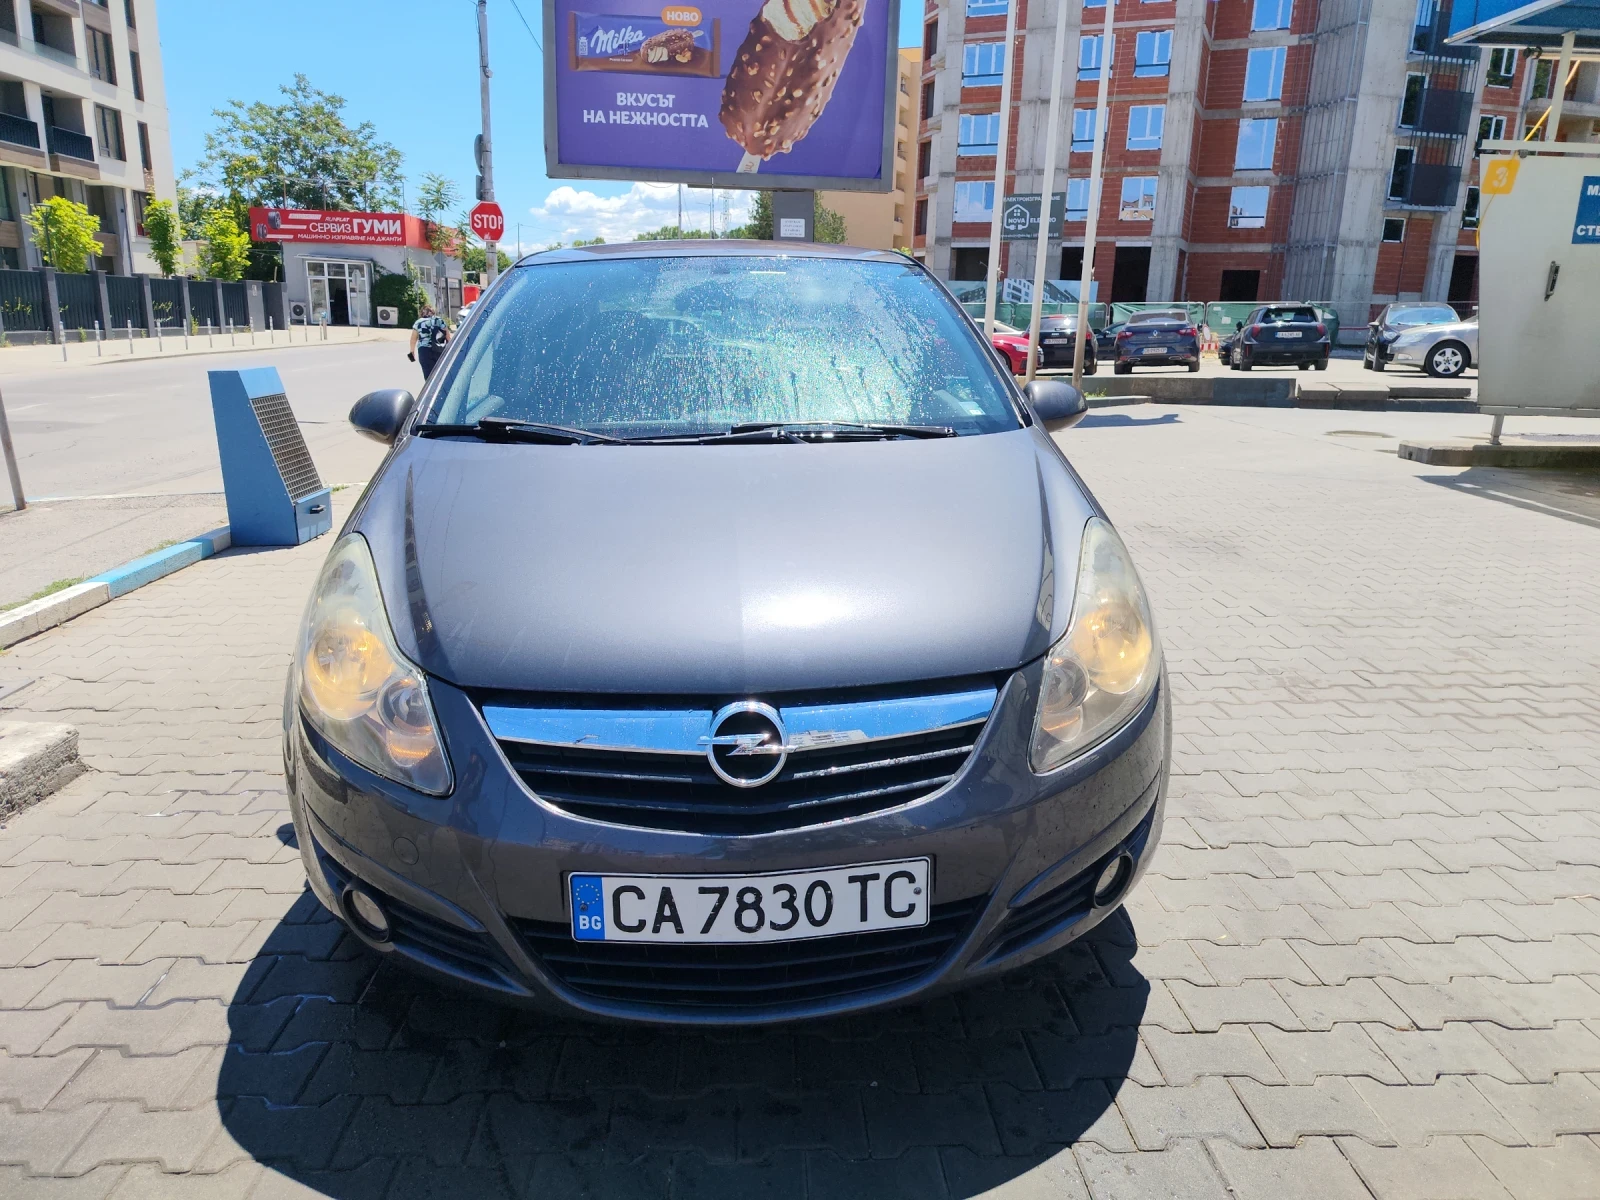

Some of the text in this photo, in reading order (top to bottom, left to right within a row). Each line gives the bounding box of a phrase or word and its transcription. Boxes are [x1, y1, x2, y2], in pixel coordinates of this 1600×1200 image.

[666, 11, 699, 22] НОВО
[590, 25, 645, 54] Milka
[616, 92, 676, 108] ВКУСЪТ
[583, 110, 709, 128] НА НЕЖНОСТТА
[1492, 166, 1509, 188] 3
[309, 218, 401, 235] СЕРВИЗ ГУМИ
[474, 213, 503, 230] STOP
[612, 871, 917, 934] CA 7830 TC
[579, 916, 602, 931] BG
